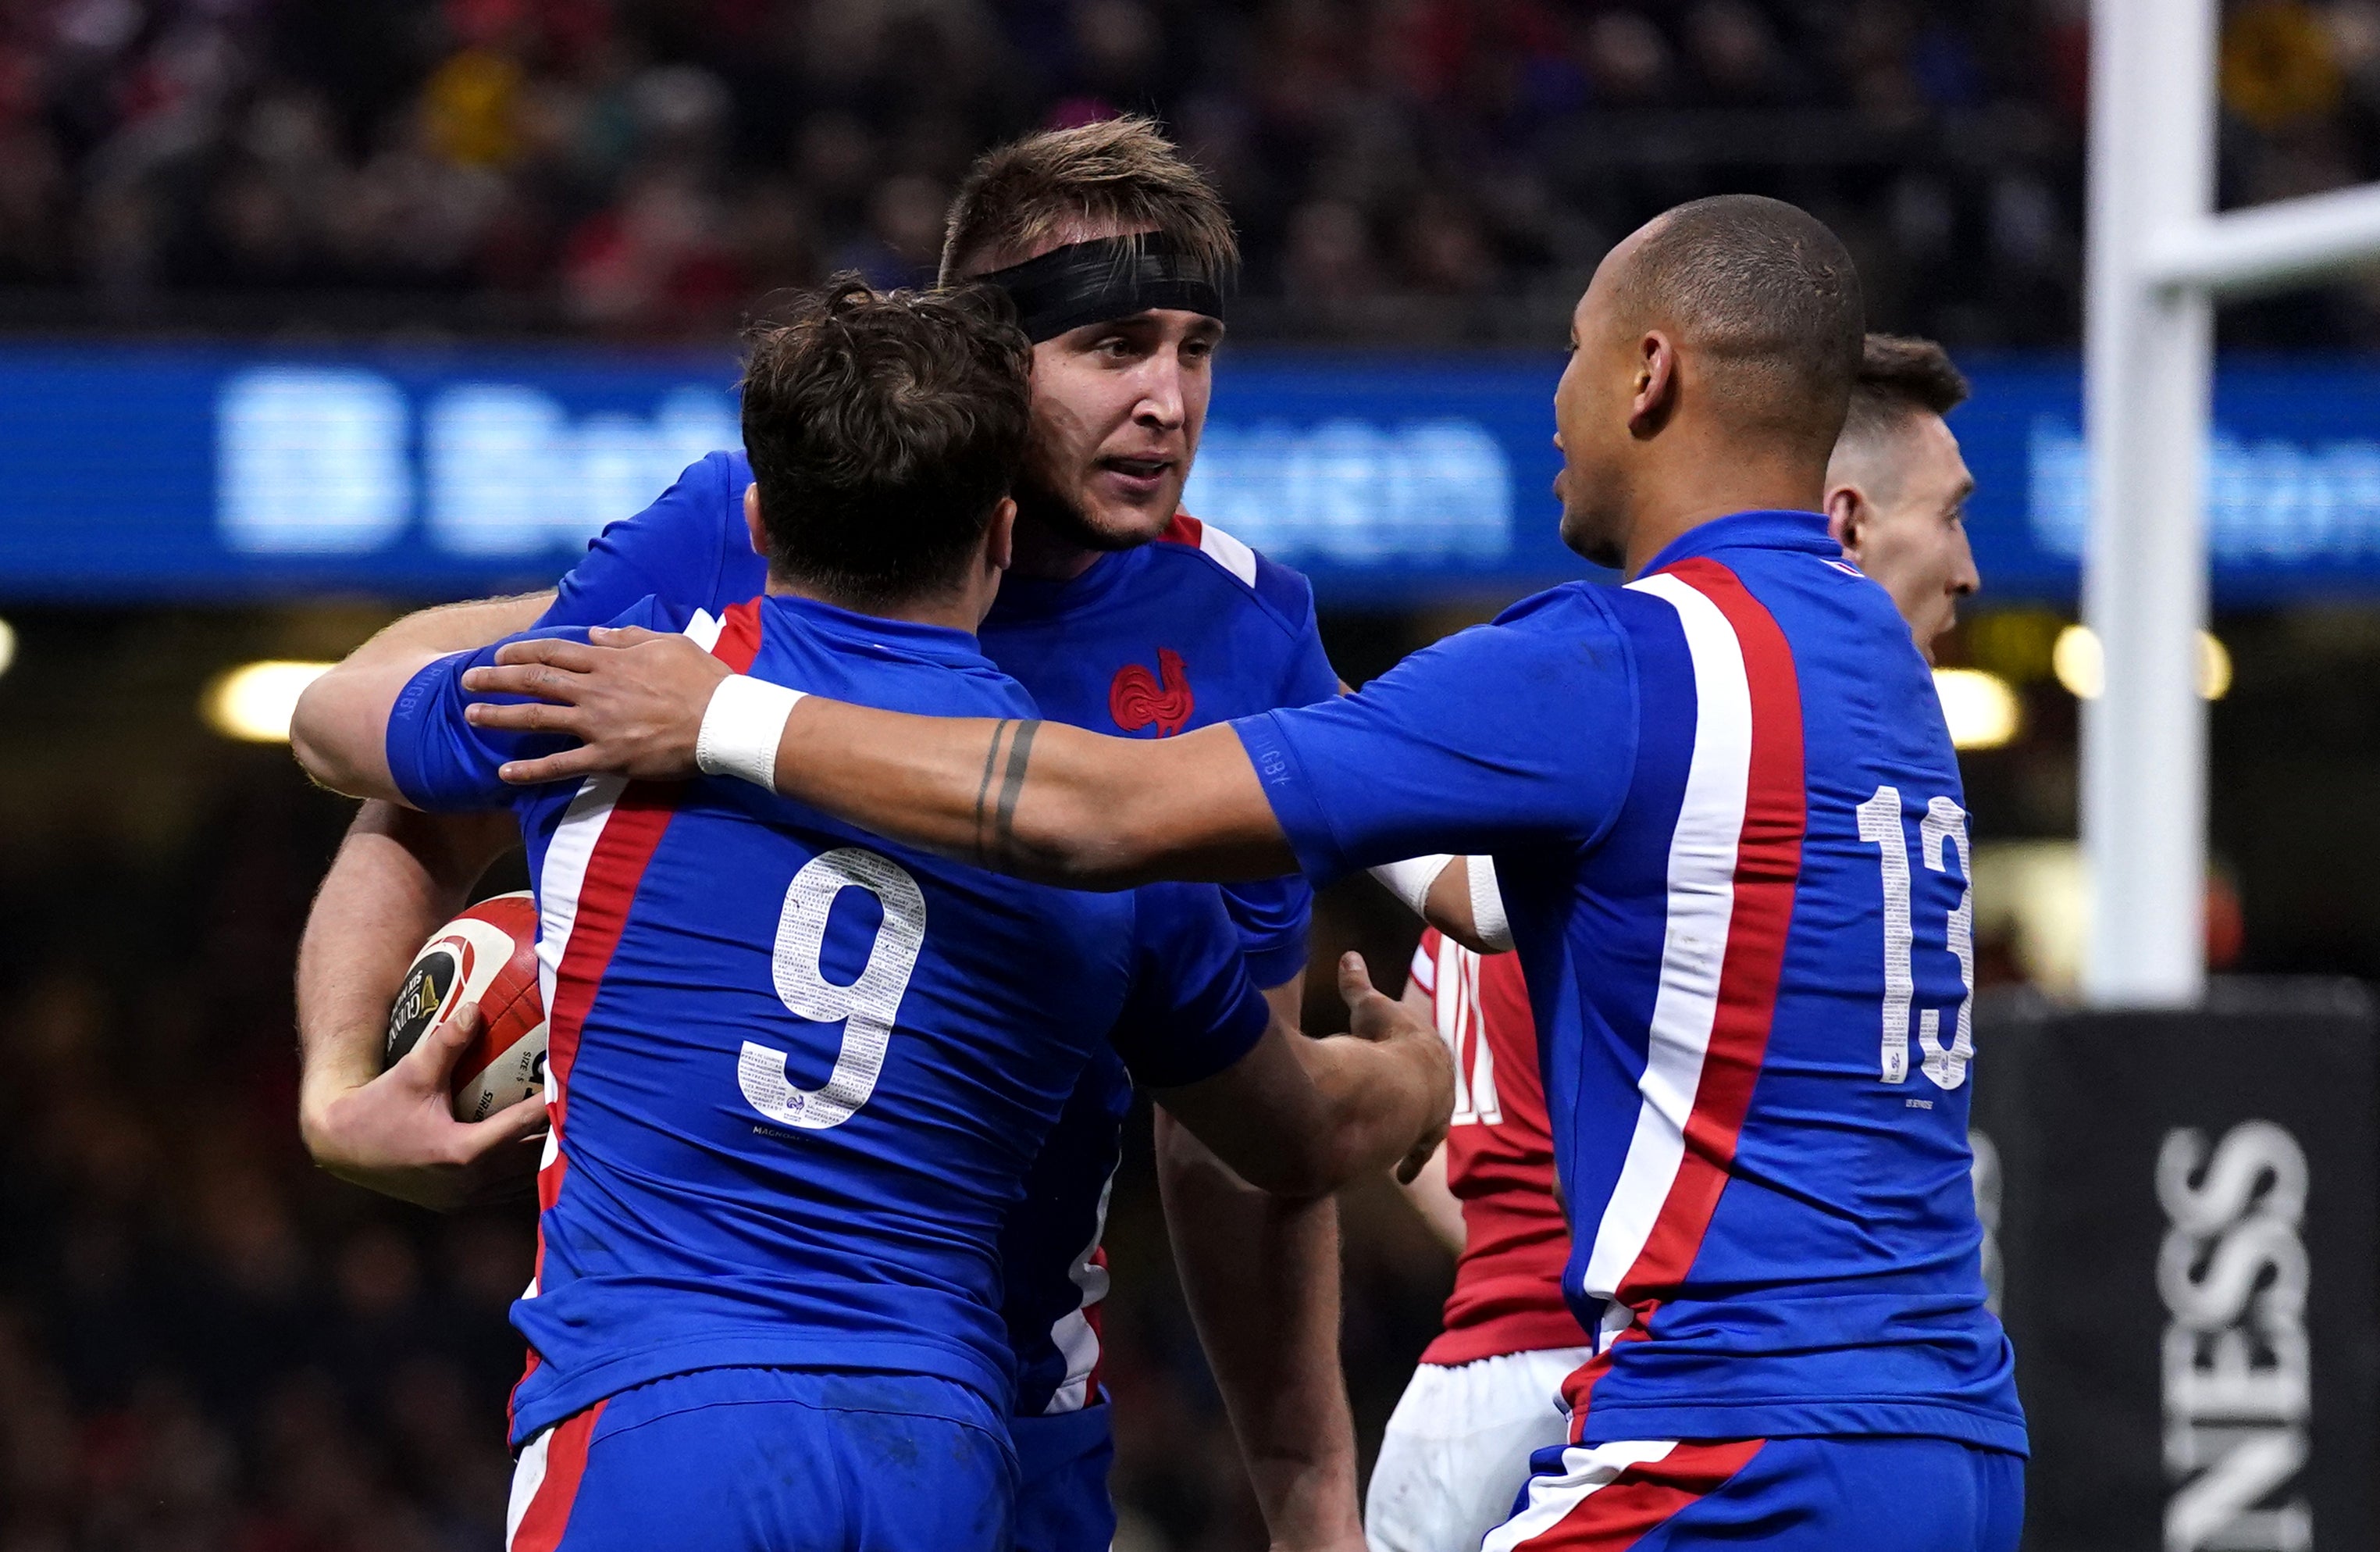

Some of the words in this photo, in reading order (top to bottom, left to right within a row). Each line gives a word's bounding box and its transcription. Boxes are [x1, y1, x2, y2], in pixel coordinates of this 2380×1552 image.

[520, 1051, 532, 1071] SIZE
[738, 847, 927, 1130] 9
[1856, 786, 1975, 1091] 13
